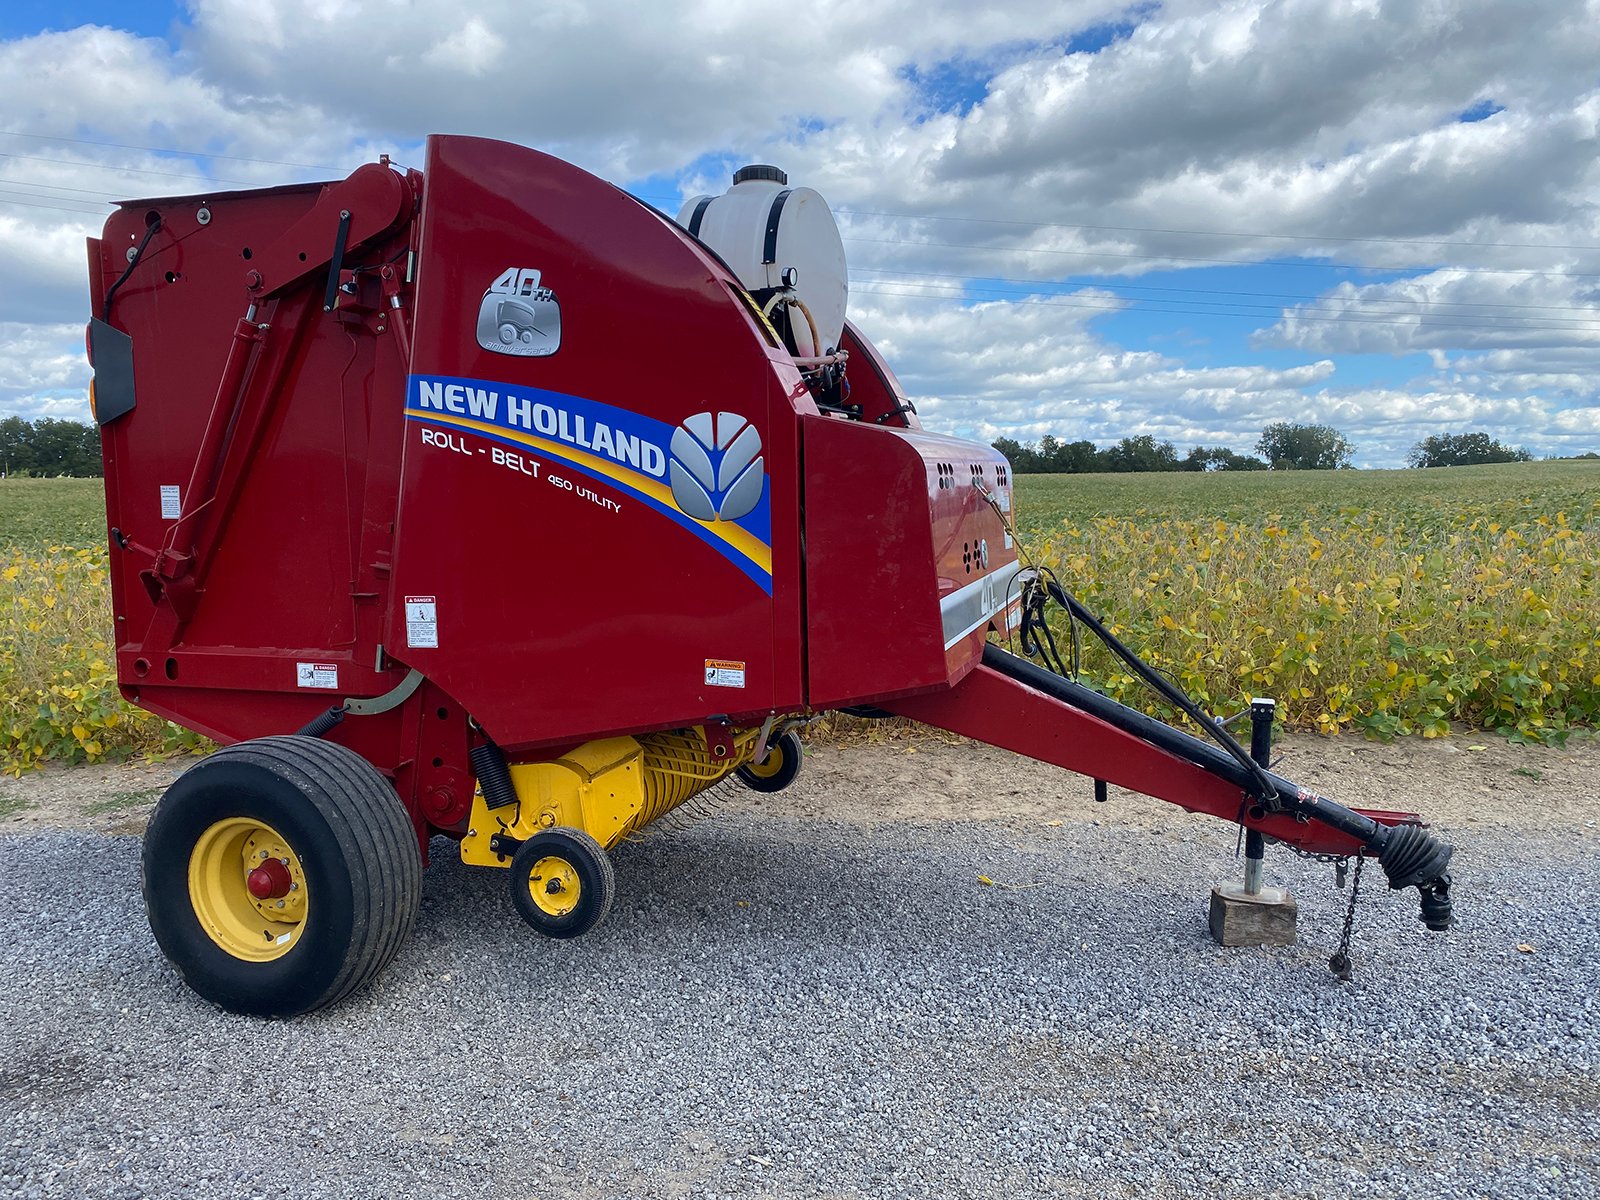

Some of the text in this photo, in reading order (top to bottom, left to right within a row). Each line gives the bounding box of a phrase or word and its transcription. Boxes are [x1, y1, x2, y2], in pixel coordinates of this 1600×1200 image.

[490, 267, 553, 302] 40TH
[419, 380, 666, 477] NEW HOLLAND
[421, 428, 472, 455] ROLL
[492, 447, 541, 478] BELT
[547, 474, 573, 491] 450
[576, 485, 621, 513] UTILITY
